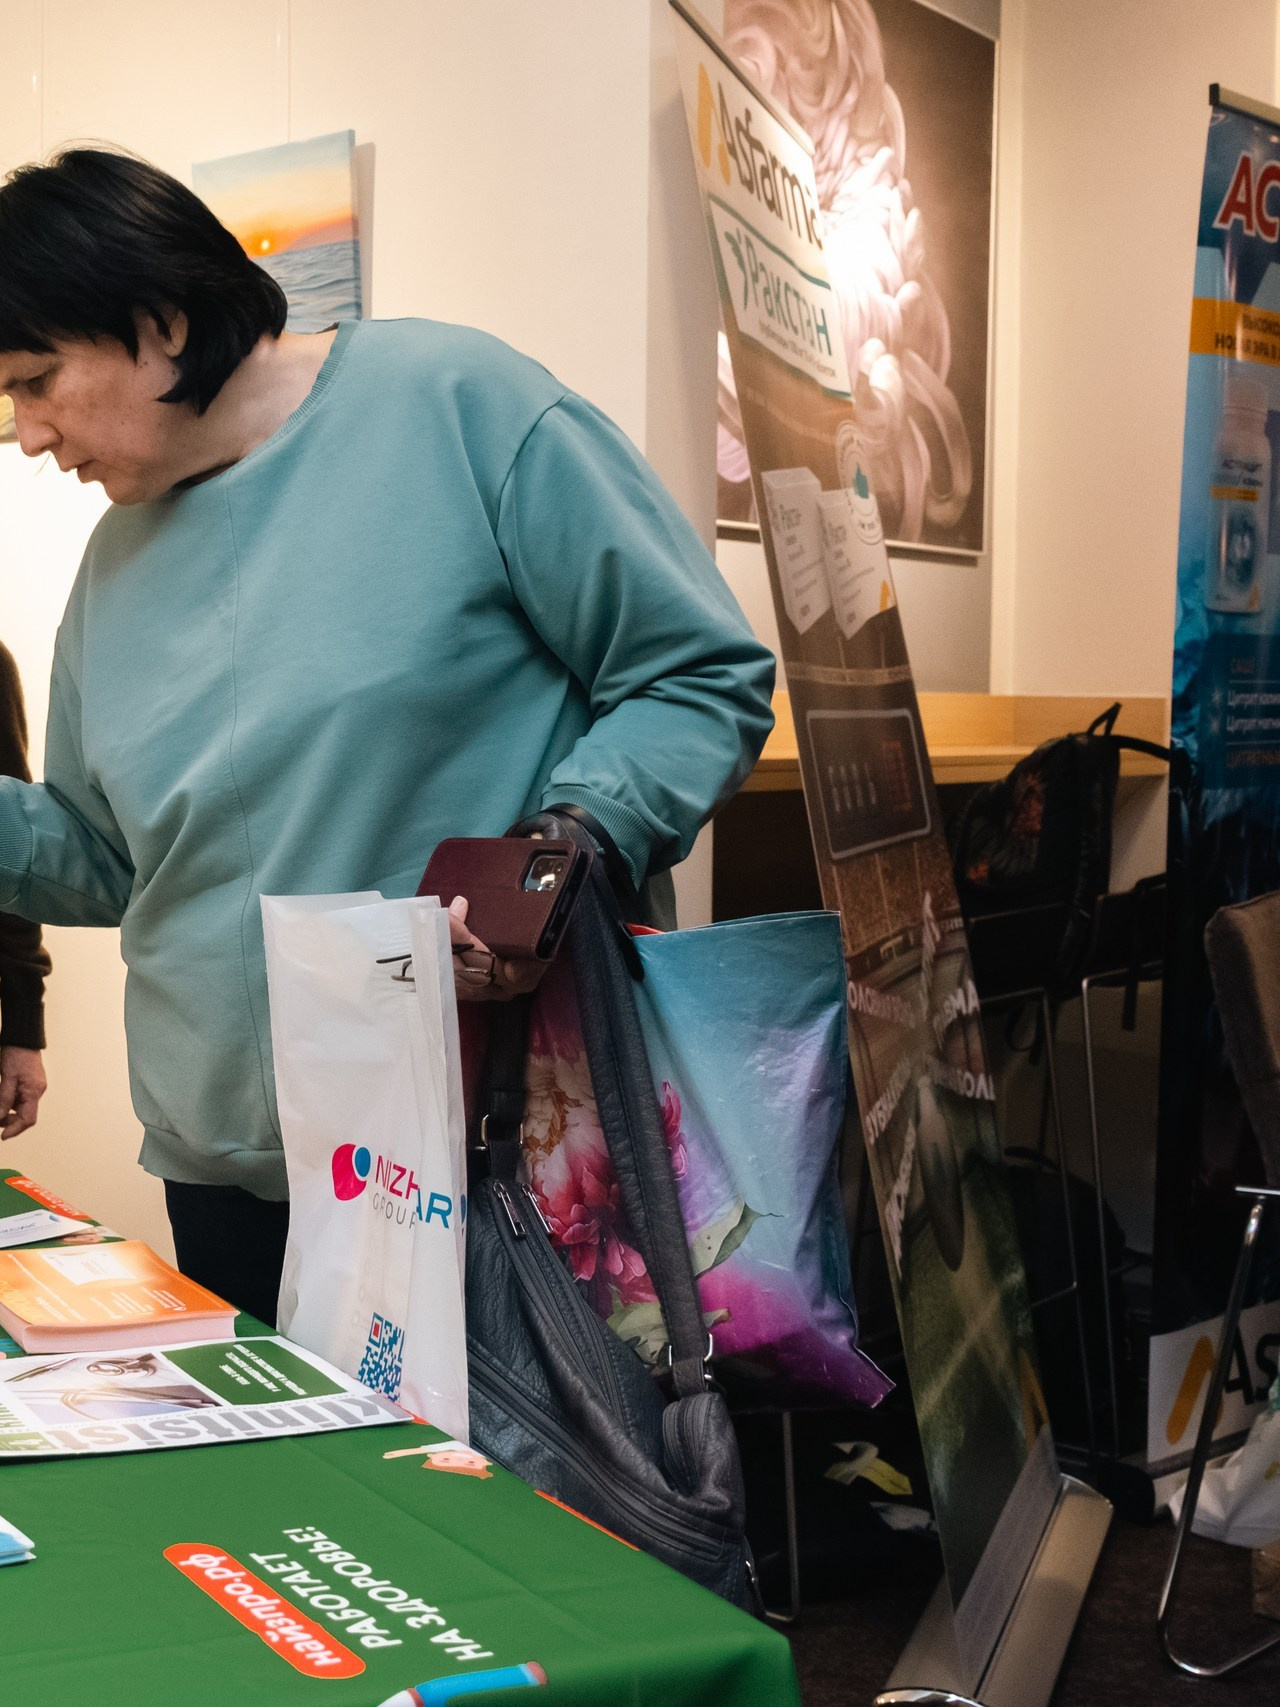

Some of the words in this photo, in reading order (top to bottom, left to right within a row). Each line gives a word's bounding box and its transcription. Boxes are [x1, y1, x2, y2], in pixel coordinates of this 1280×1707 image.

[51, 1395, 408, 1453] klinitsist
[178, 1550, 342, 1666] найзпро.рф
[248, 1552, 404, 1650] РАБОТАЕТ
[282, 1525, 447, 1630] ЗДОРОВЬЕ!
[431, 1627, 495, 1662] НА
